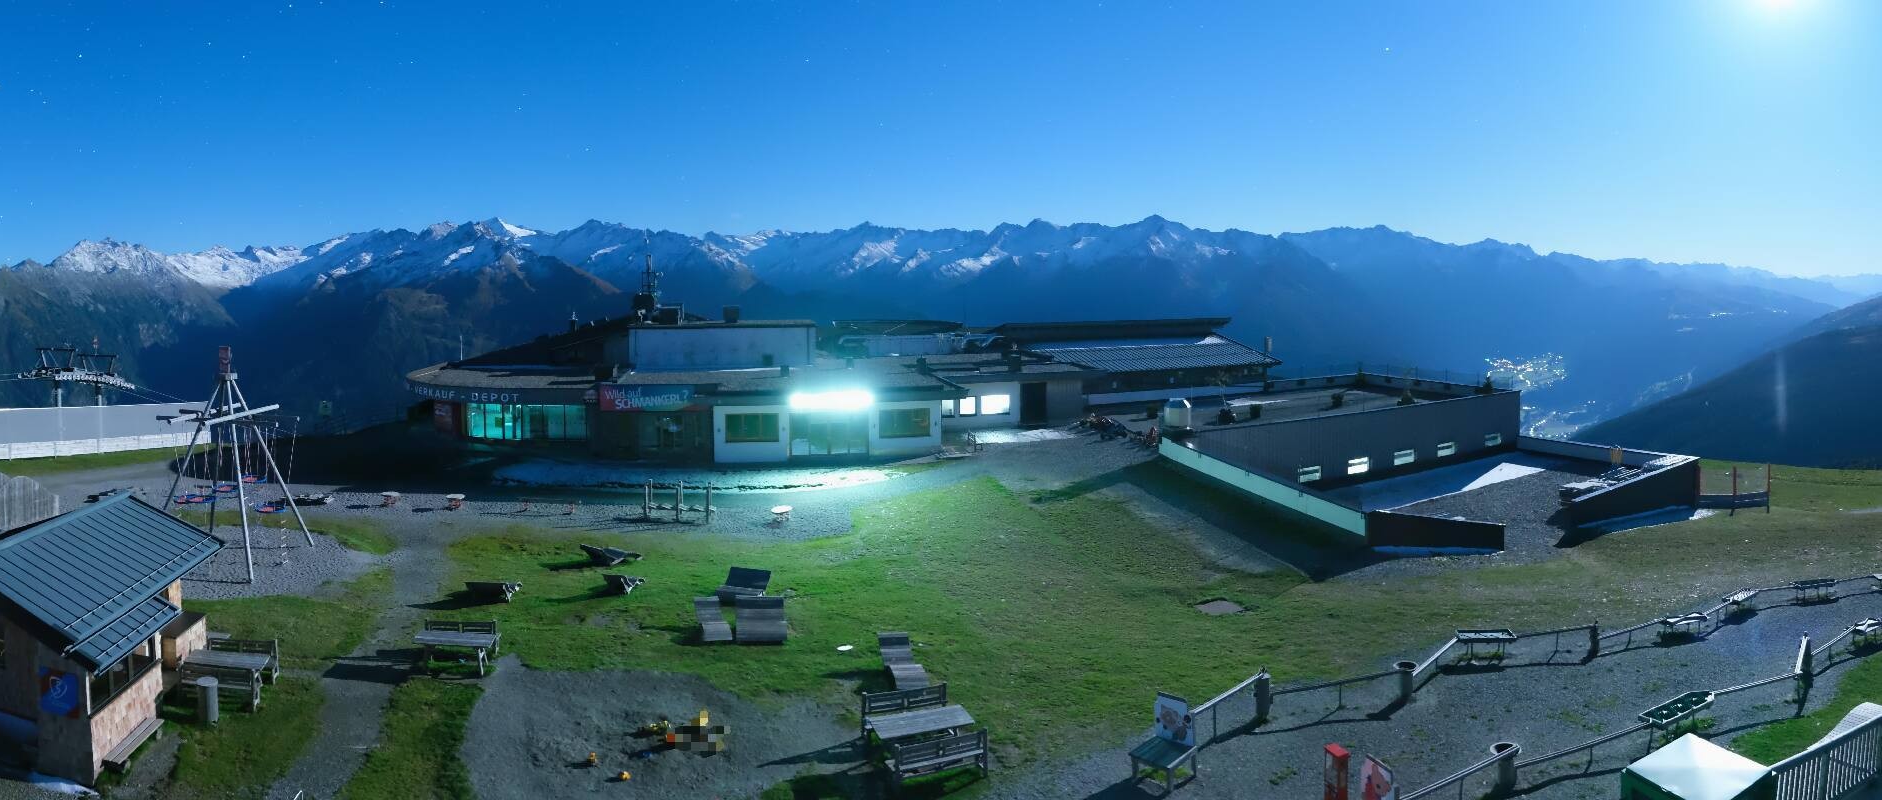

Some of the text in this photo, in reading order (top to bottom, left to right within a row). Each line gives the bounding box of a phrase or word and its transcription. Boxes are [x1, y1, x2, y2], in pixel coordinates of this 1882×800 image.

[415, 386, 455, 400] VERKAUF
[471, 393, 520, 402] DEPOT
[605, 386, 642, 400] Wild auf
